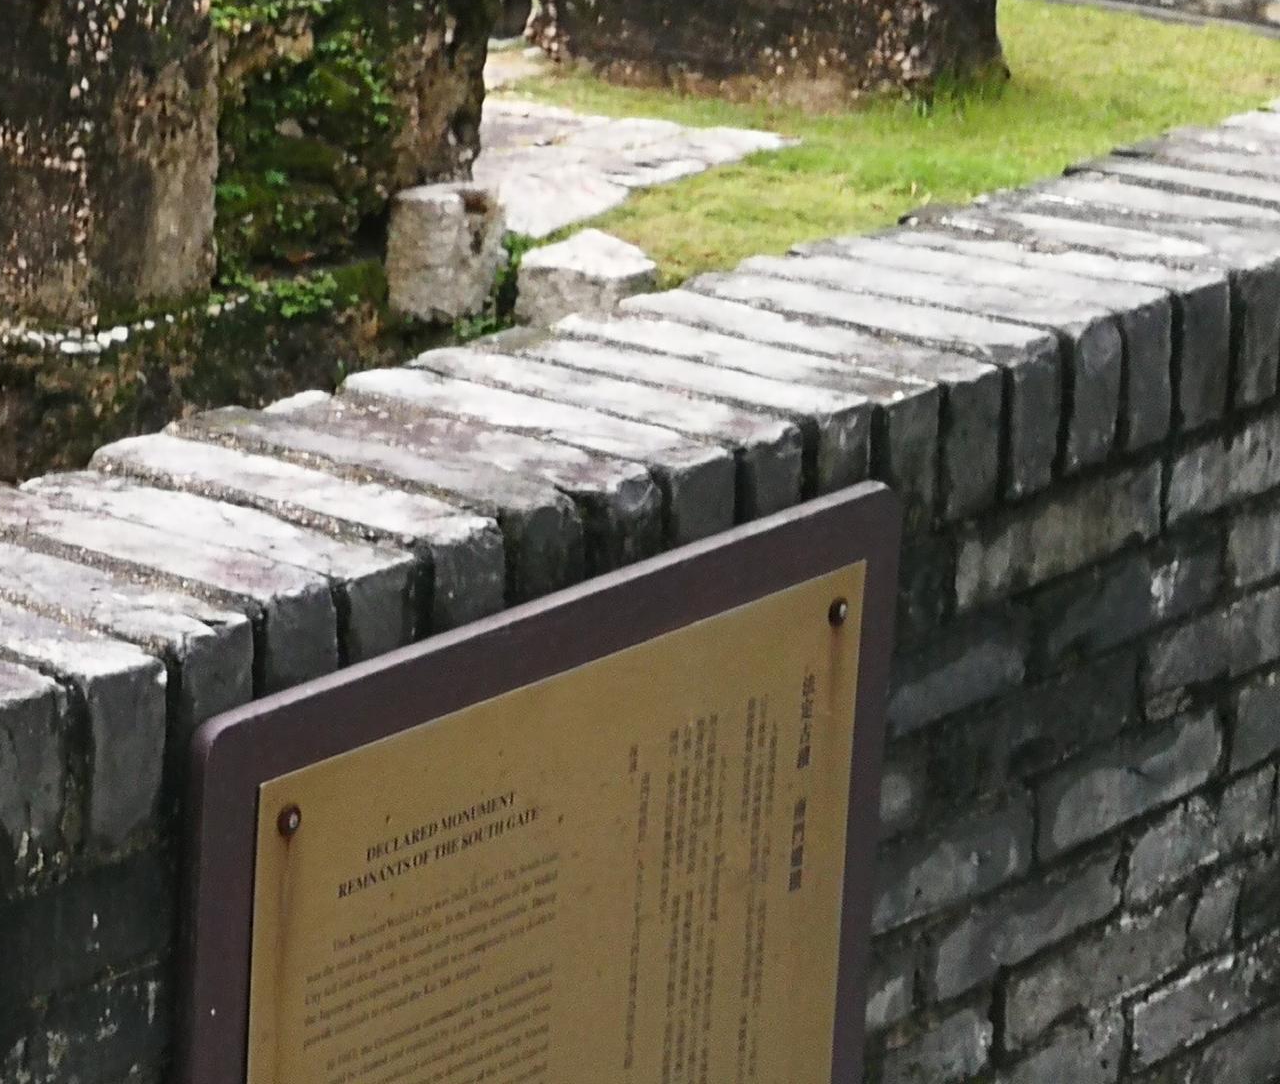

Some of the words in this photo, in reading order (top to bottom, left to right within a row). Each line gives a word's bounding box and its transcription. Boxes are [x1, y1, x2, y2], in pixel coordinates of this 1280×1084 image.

[338, 860, 411, 898] REMNANTS
[413, 848, 431, 867] OF
[434, 839, 461, 860] THE
[462, 820, 505, 850] SOUTH
[506, 807, 540, 830] GATE
[367, 823, 438, 862] DECLARED
[440, 792, 515, 831] MONUMENT
